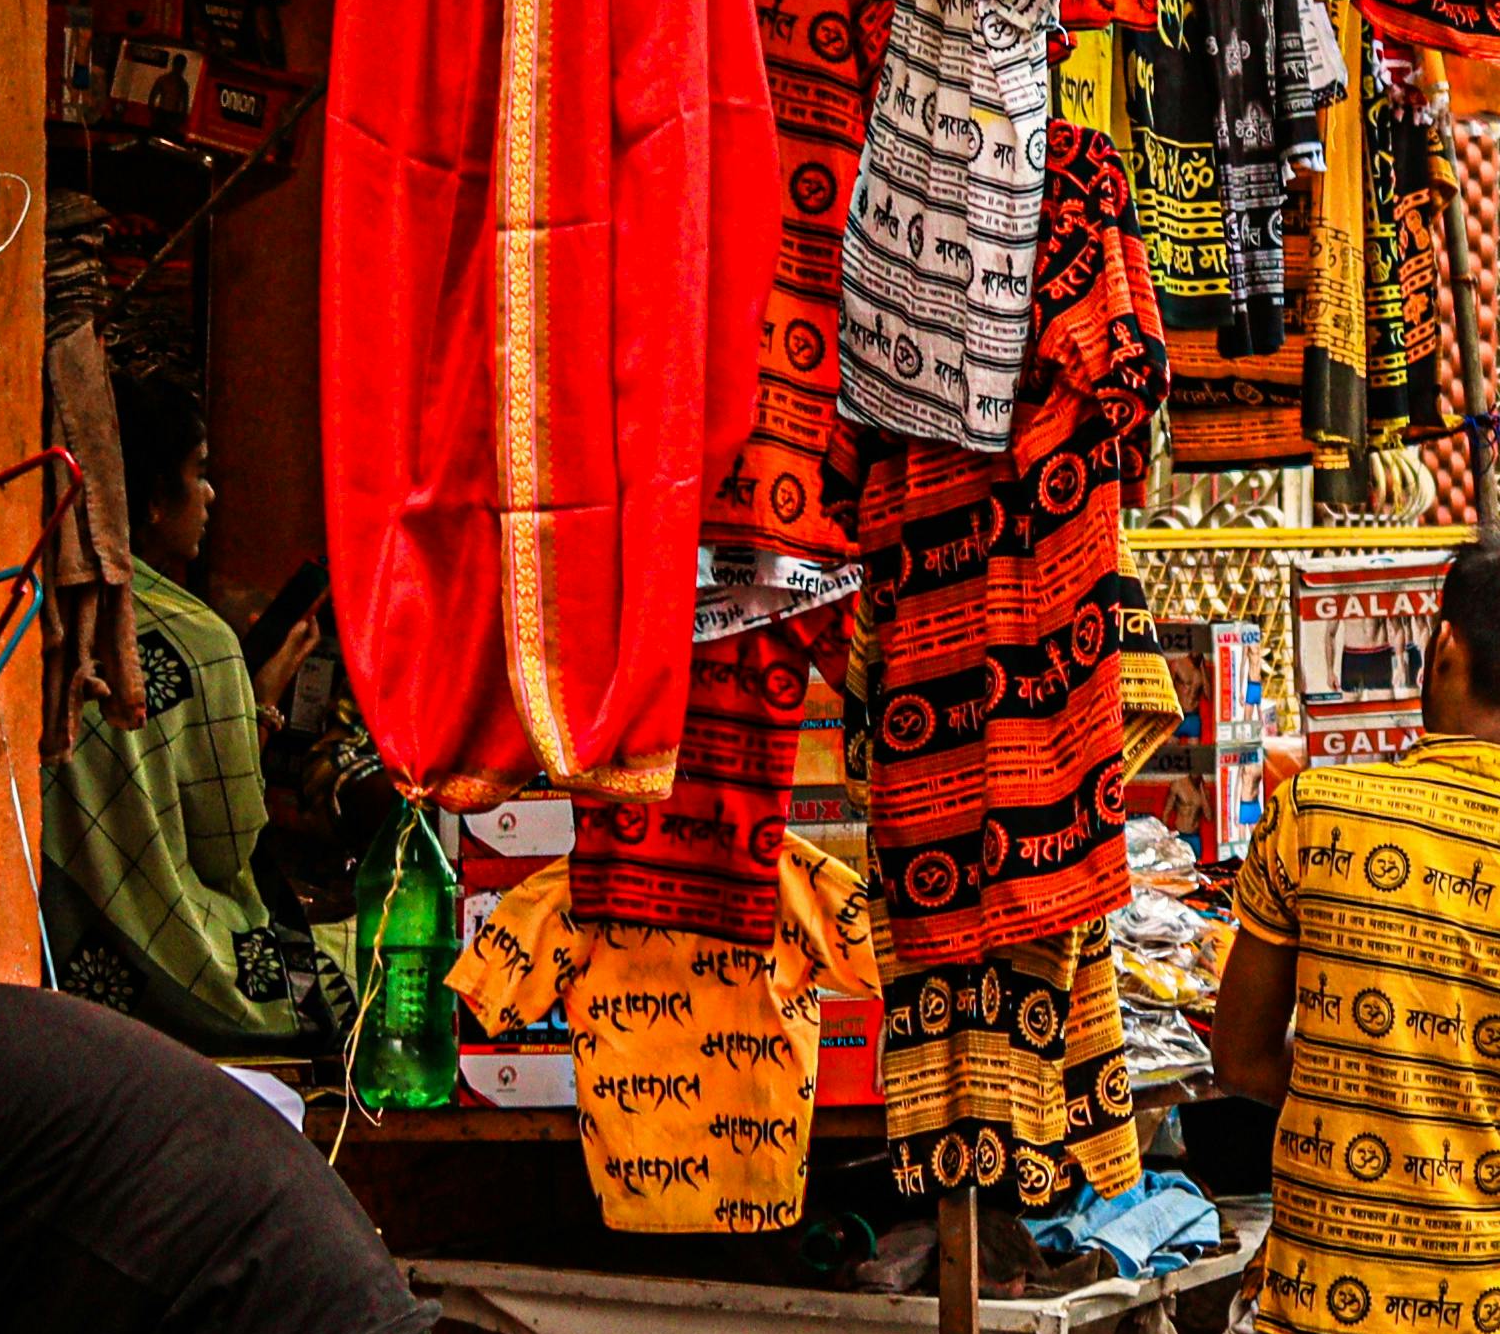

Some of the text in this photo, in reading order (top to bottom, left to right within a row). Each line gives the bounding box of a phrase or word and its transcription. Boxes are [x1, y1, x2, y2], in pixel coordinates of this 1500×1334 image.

[1315, 592, 1439, 619] GALAX
[1160, 628, 1193, 652] ozi
[1217, 632, 1239, 644] LUX
[1323, 728, 1420, 755] GALA
[787, 800, 844, 822] UX
[1423, 856, 1495, 912] महाकाल
[589, 992, 693, 1033] महाकाल
[701, 1030, 795, 1070] महाकाल
[837, 1036, 866, 1047] PLAIN
[593, 1073, 701, 1114] महाकाल
[709, 1112, 798, 1155] महाकाल
[605, 1155, 710, 1197] महाकाल
[715, 1196, 798, 1232] महाकाल
[1385, 1279, 1463, 1331] महाकाल
